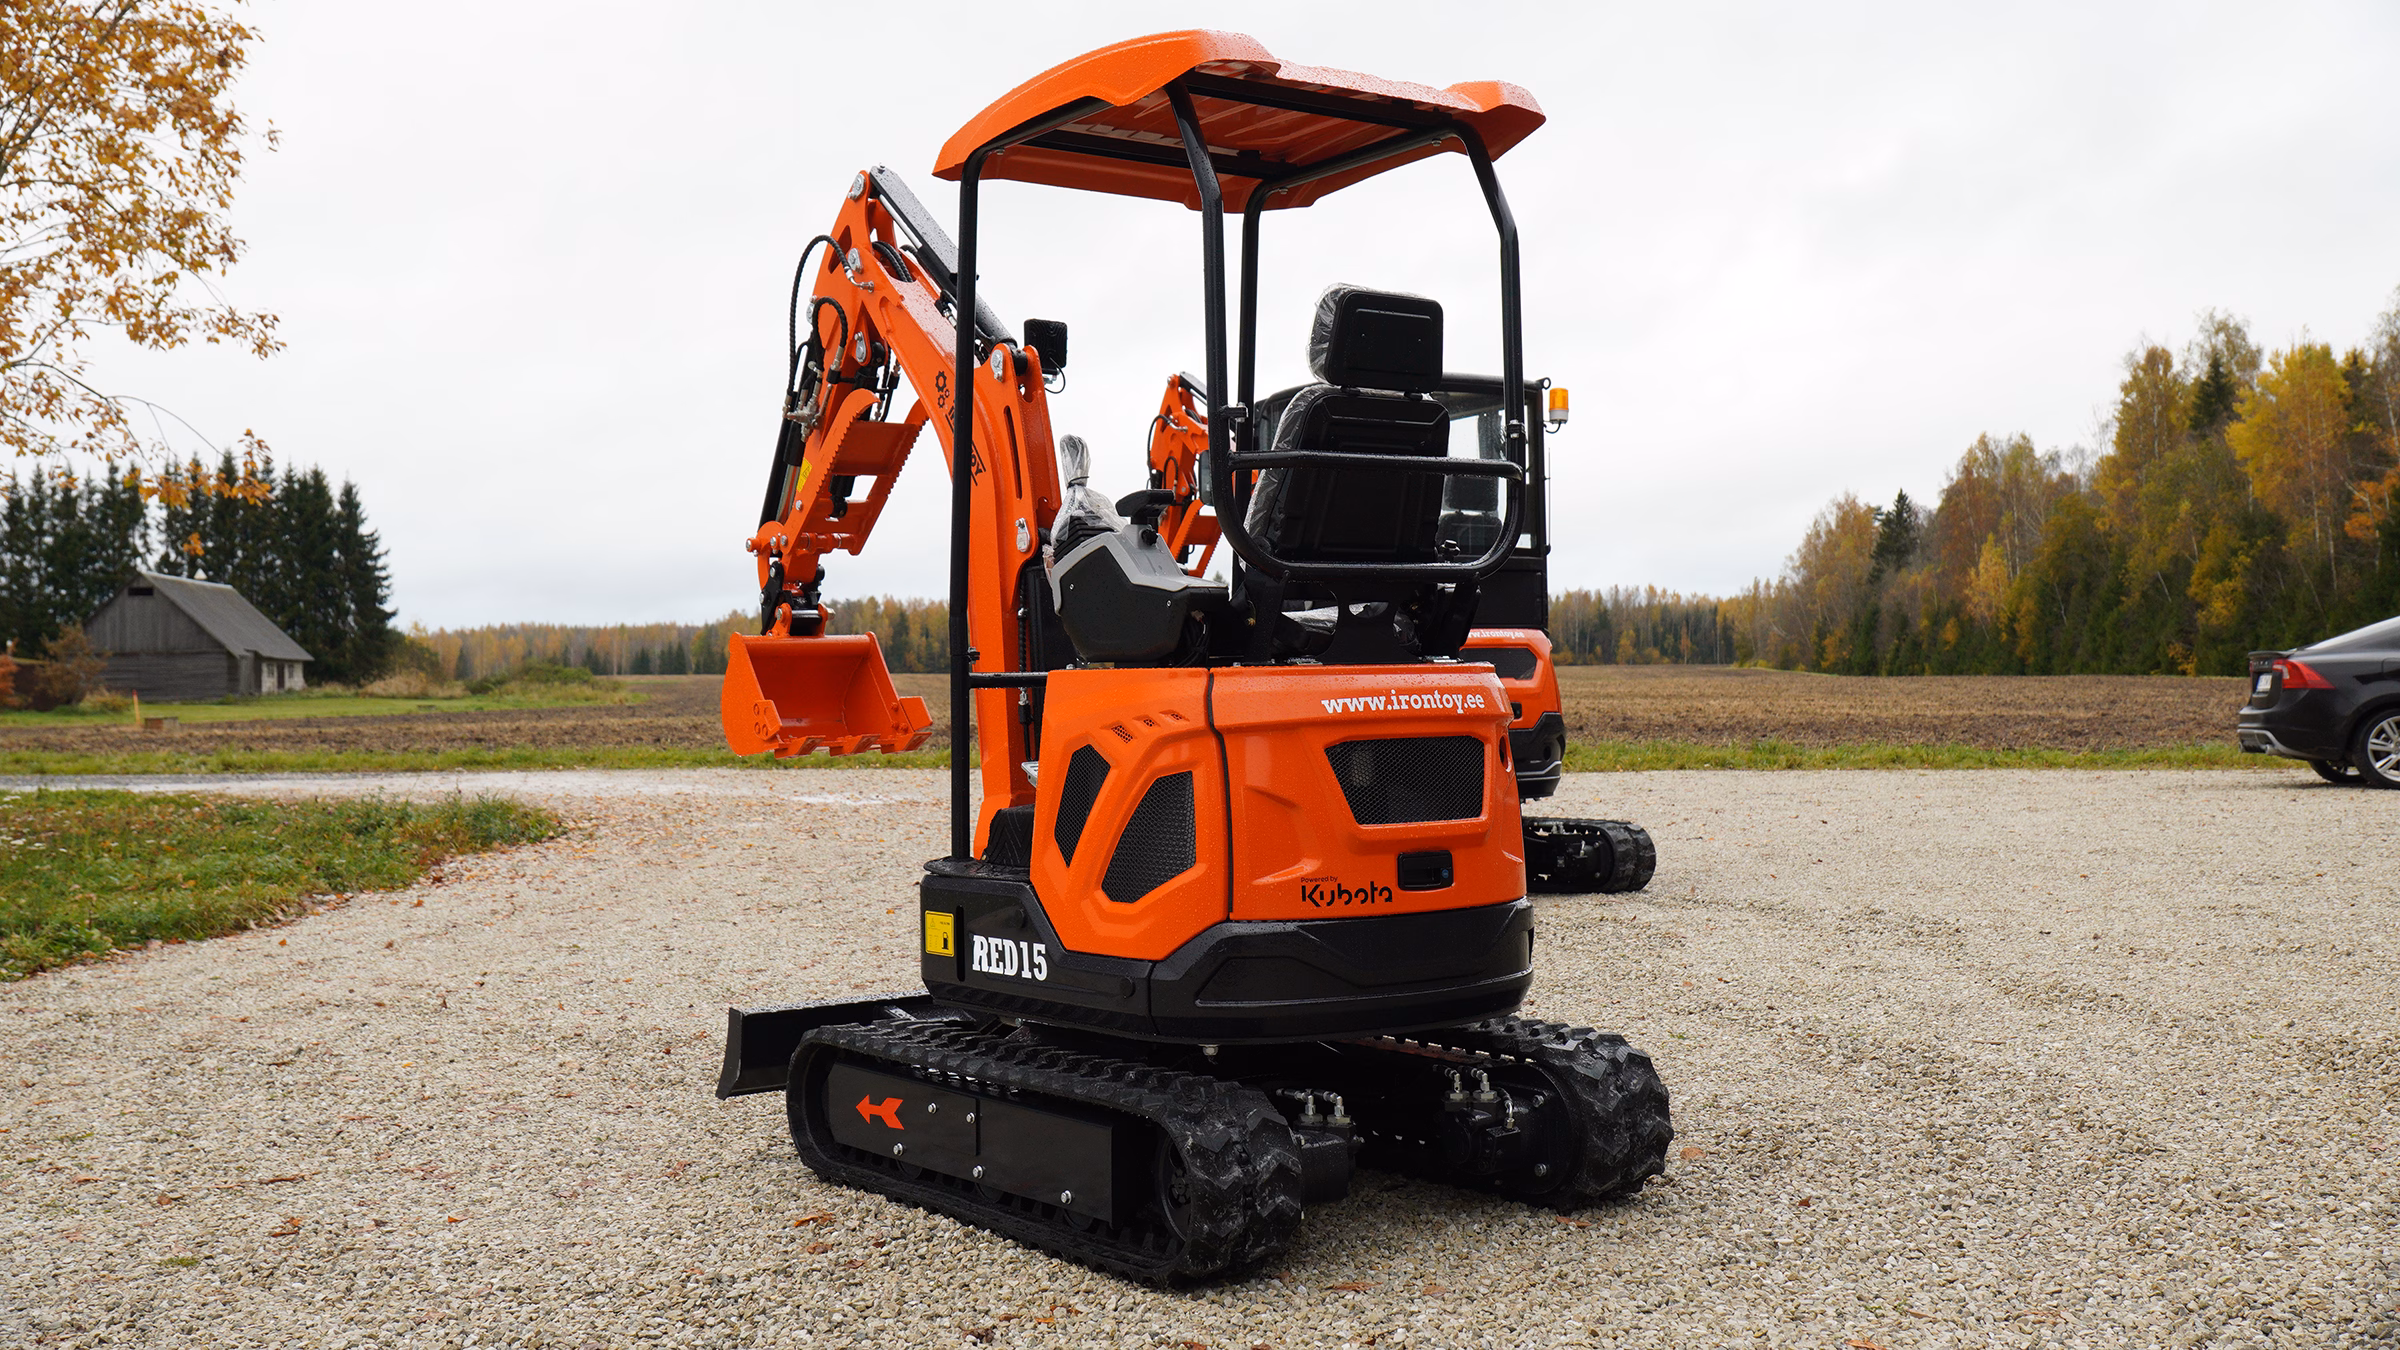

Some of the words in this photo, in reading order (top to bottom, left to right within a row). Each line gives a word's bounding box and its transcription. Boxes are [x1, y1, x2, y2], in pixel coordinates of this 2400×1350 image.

[1321, 689, 1485, 714] www.irontoy.ee
[1302, 881, 1393, 907] Kubota
[972, 934, 1048, 981] RED15
